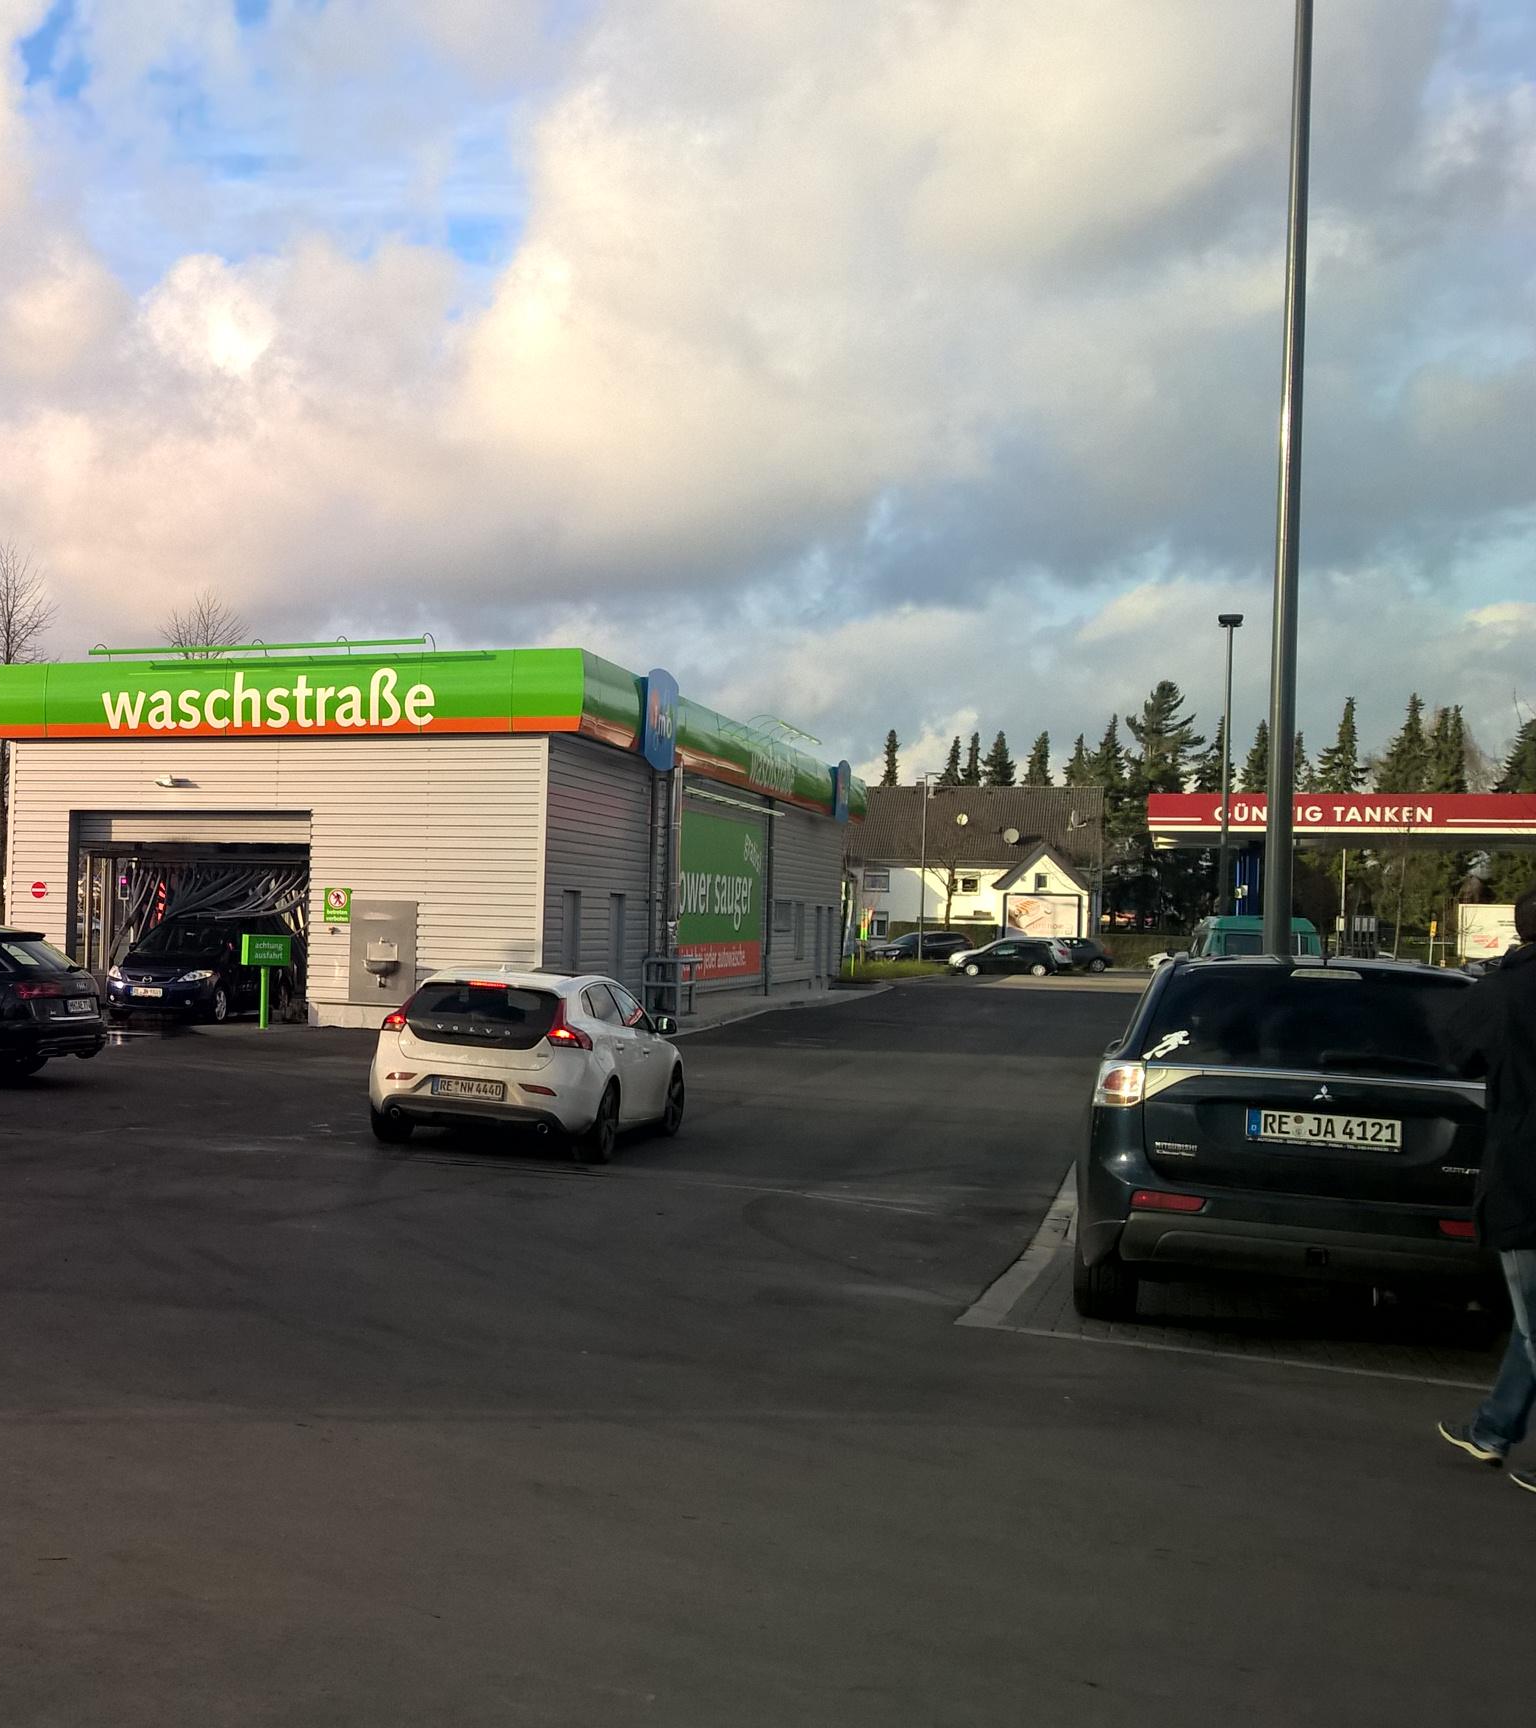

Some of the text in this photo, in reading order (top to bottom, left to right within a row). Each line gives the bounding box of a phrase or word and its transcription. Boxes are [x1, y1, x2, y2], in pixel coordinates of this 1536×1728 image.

[101, 667, 436, 730] waschstraße
[1213, 803, 1433, 822] GÜNIG TANKEN
[714, 873, 753, 931] sauger
[254, 941, 283, 951] achtung
[254, 951, 283, 960] ausfahrt
[437, 1023, 511, 1036] VOLVO
[440, 1080, 453, 1092] RE
[460, 1083, 474, 1093] NW
[1263, 1113, 1398, 1143] RE JA 4121
